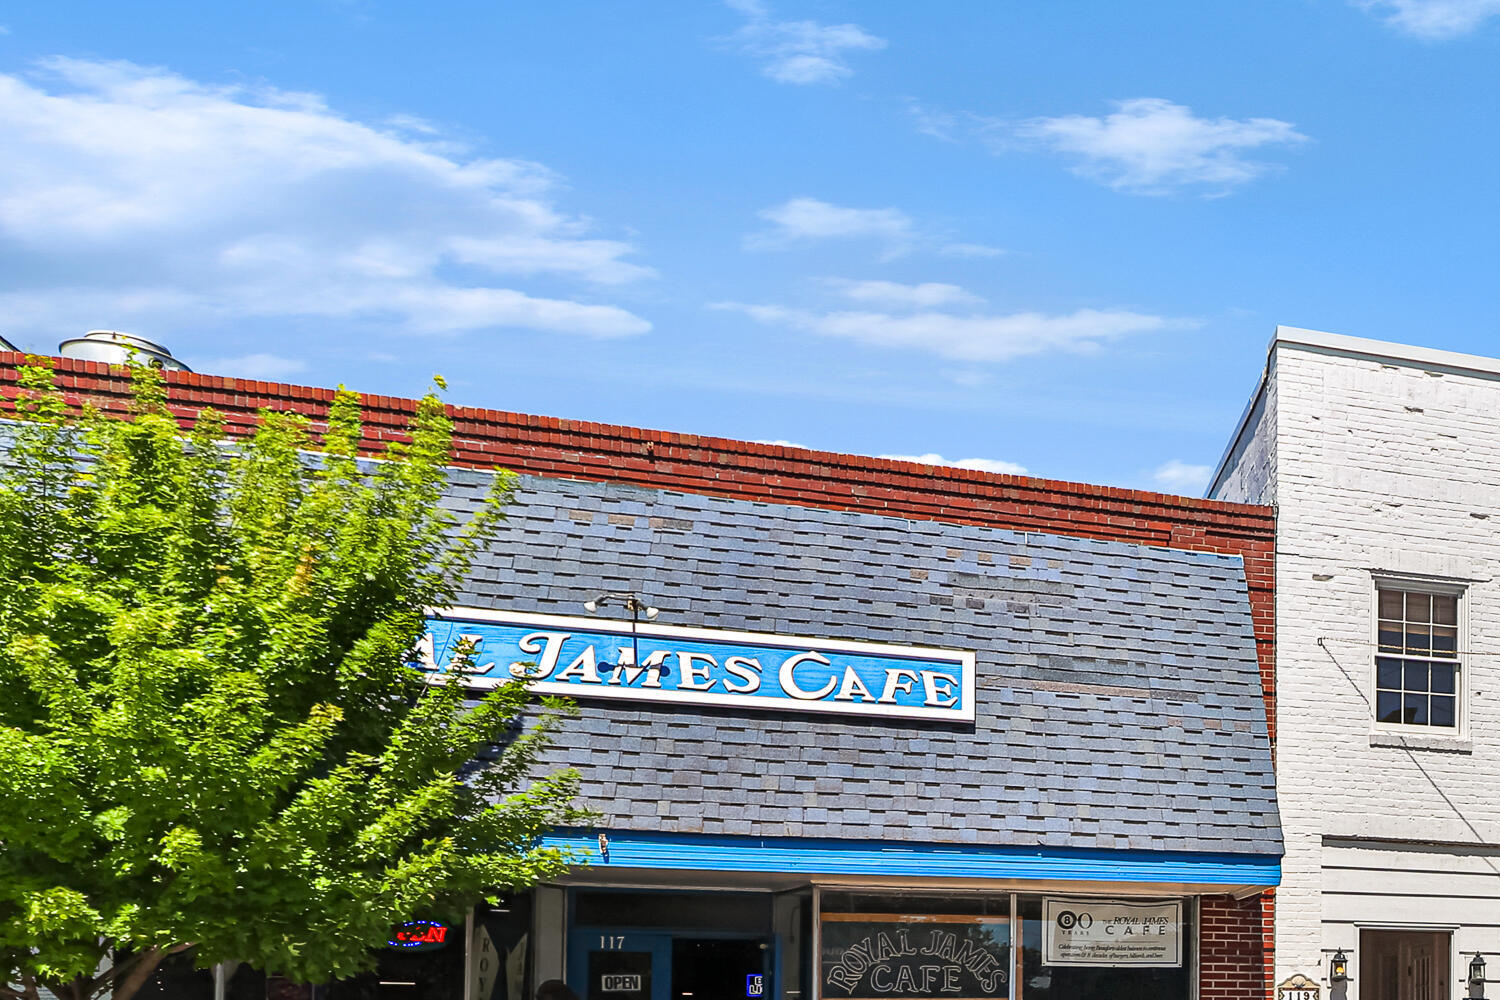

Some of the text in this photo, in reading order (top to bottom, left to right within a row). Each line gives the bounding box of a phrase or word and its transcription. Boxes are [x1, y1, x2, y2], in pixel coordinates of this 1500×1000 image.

[509, 632, 763, 694] JAMES
[778, 650, 959, 709] CAFE
[1113, 916, 1140, 925] ROYAL
[1105, 925, 1167, 936] CAFE
[600, 935, 625, 950] 117
[827, 929, 1008, 995] ROYAL JAMES
[604, 975, 640, 990] OPEN
[870, 965, 962, 993] CAFE
[1289, 991, 1310, 1000] 119
